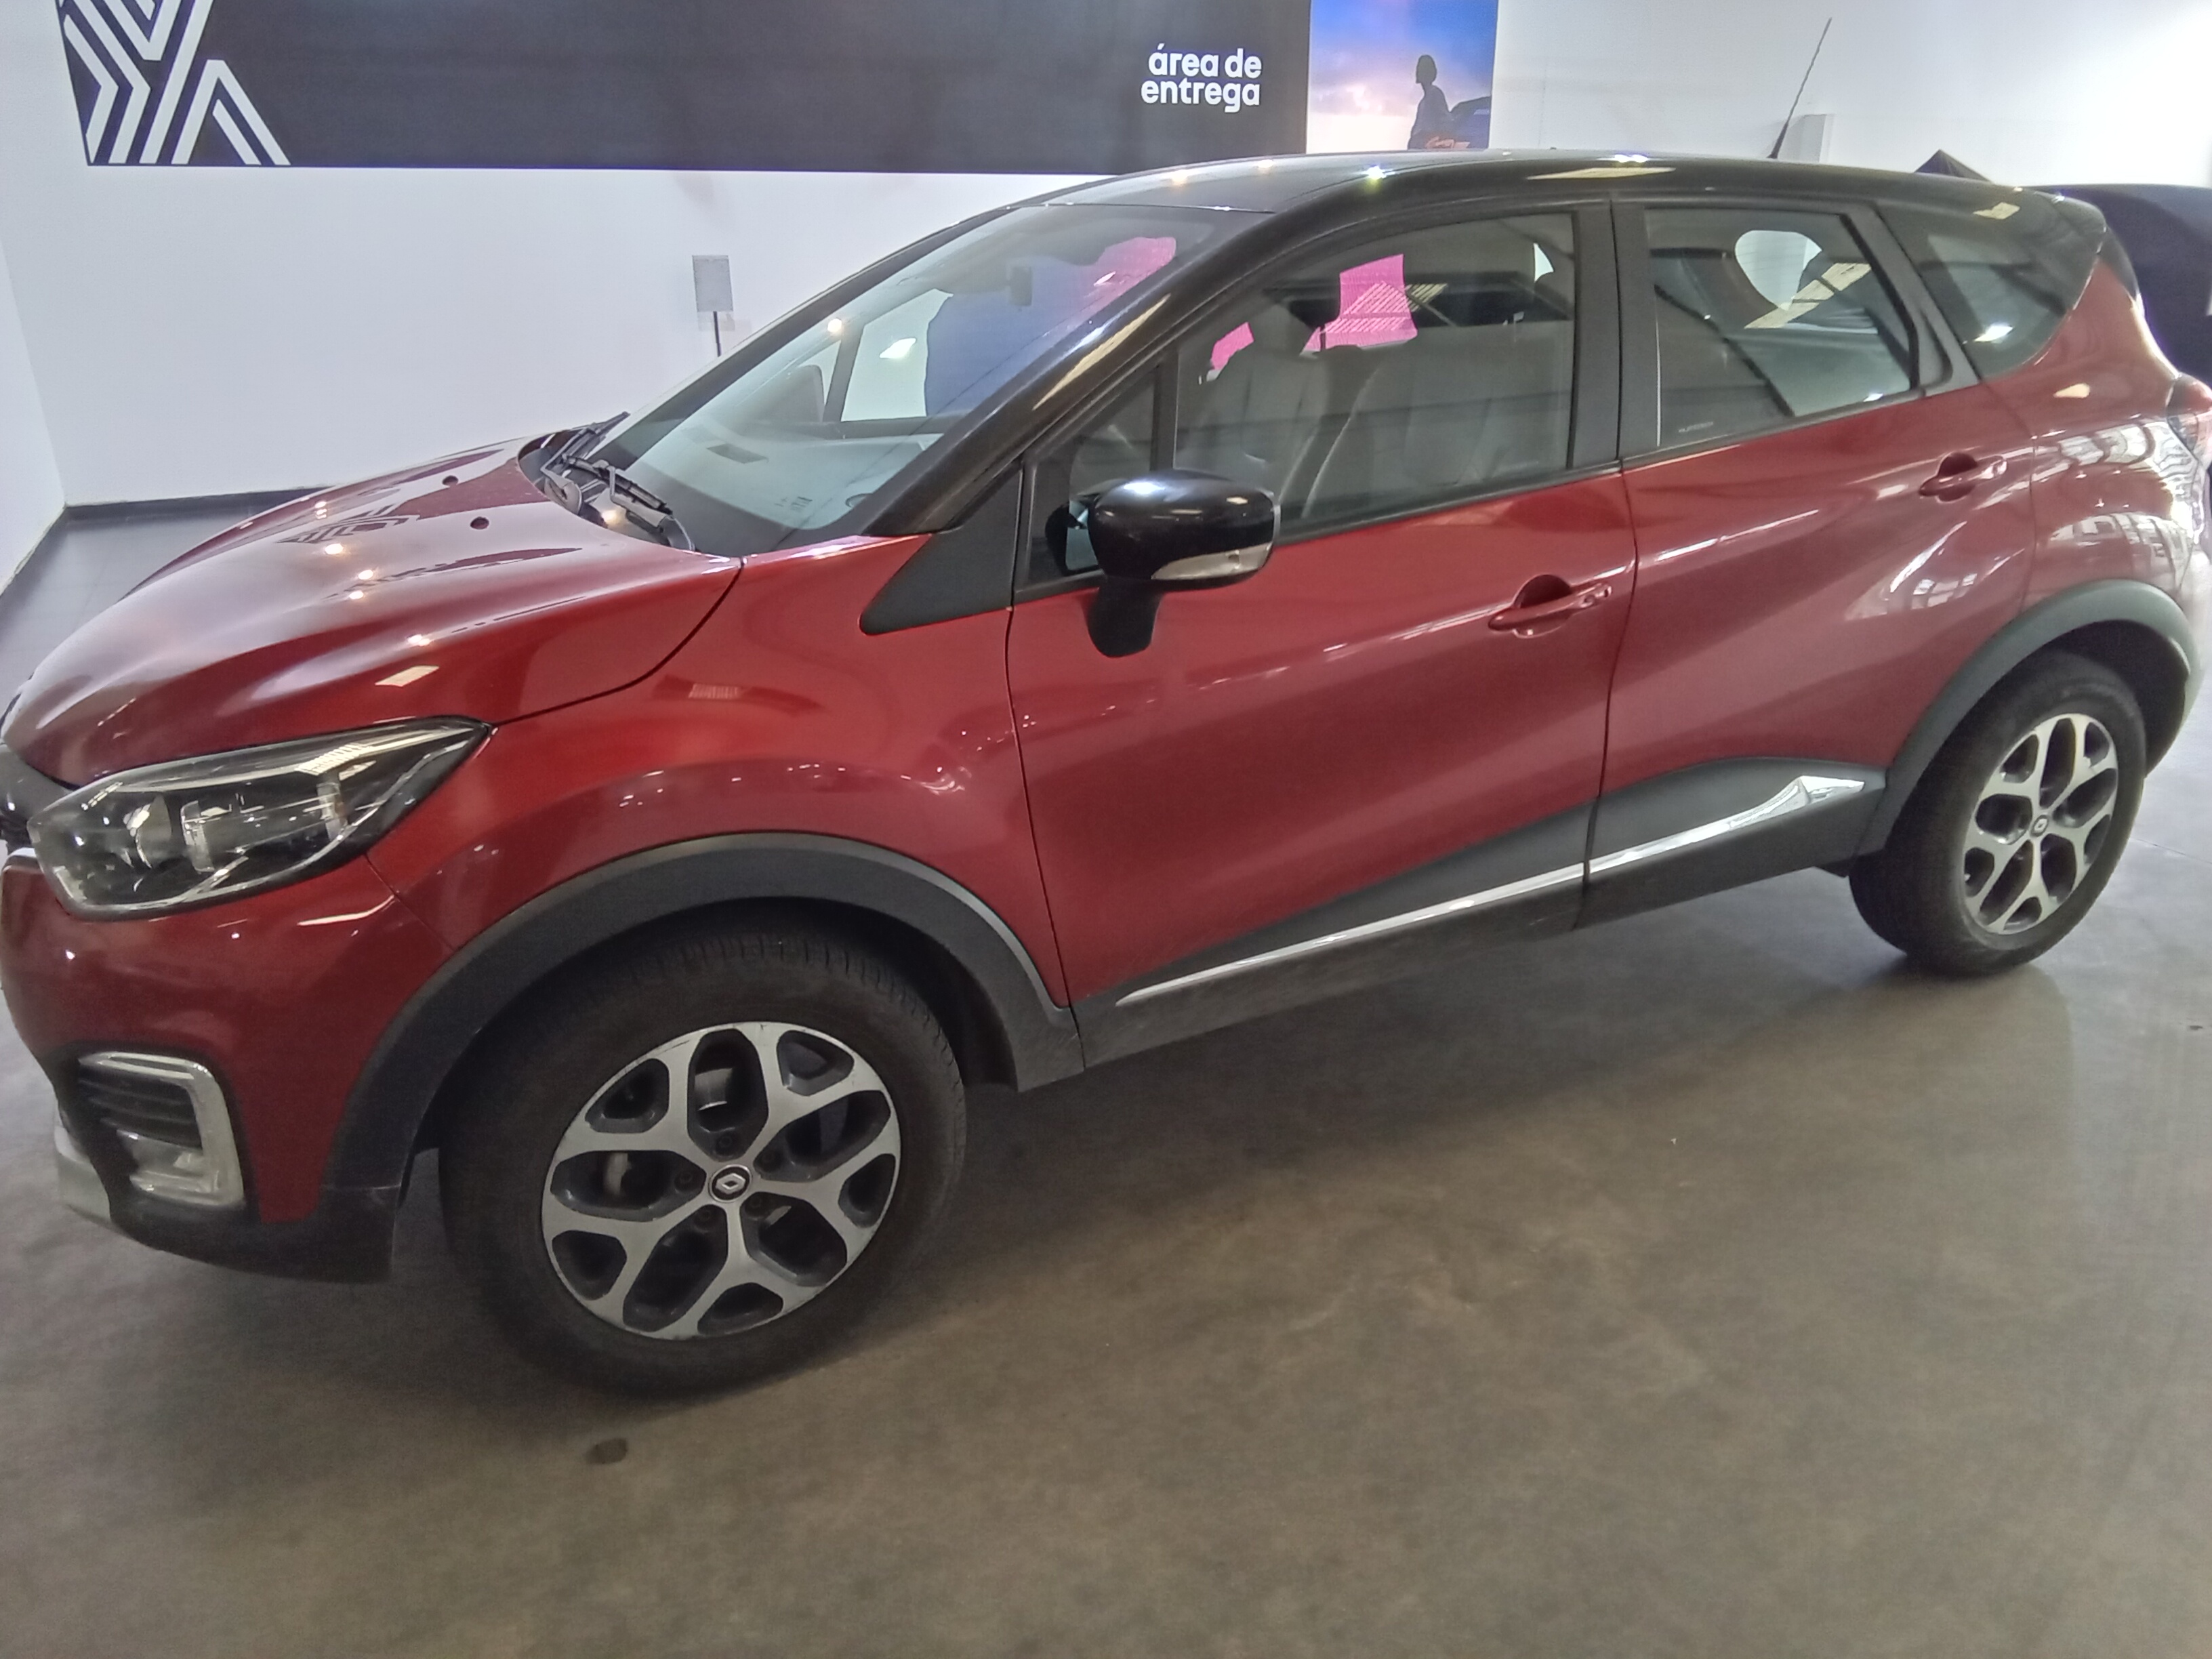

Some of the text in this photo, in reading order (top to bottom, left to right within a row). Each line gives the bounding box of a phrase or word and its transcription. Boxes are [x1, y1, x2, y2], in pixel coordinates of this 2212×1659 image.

[1148, 43, 1262, 79] área de
[1141, 77, 1261, 113] entrega
